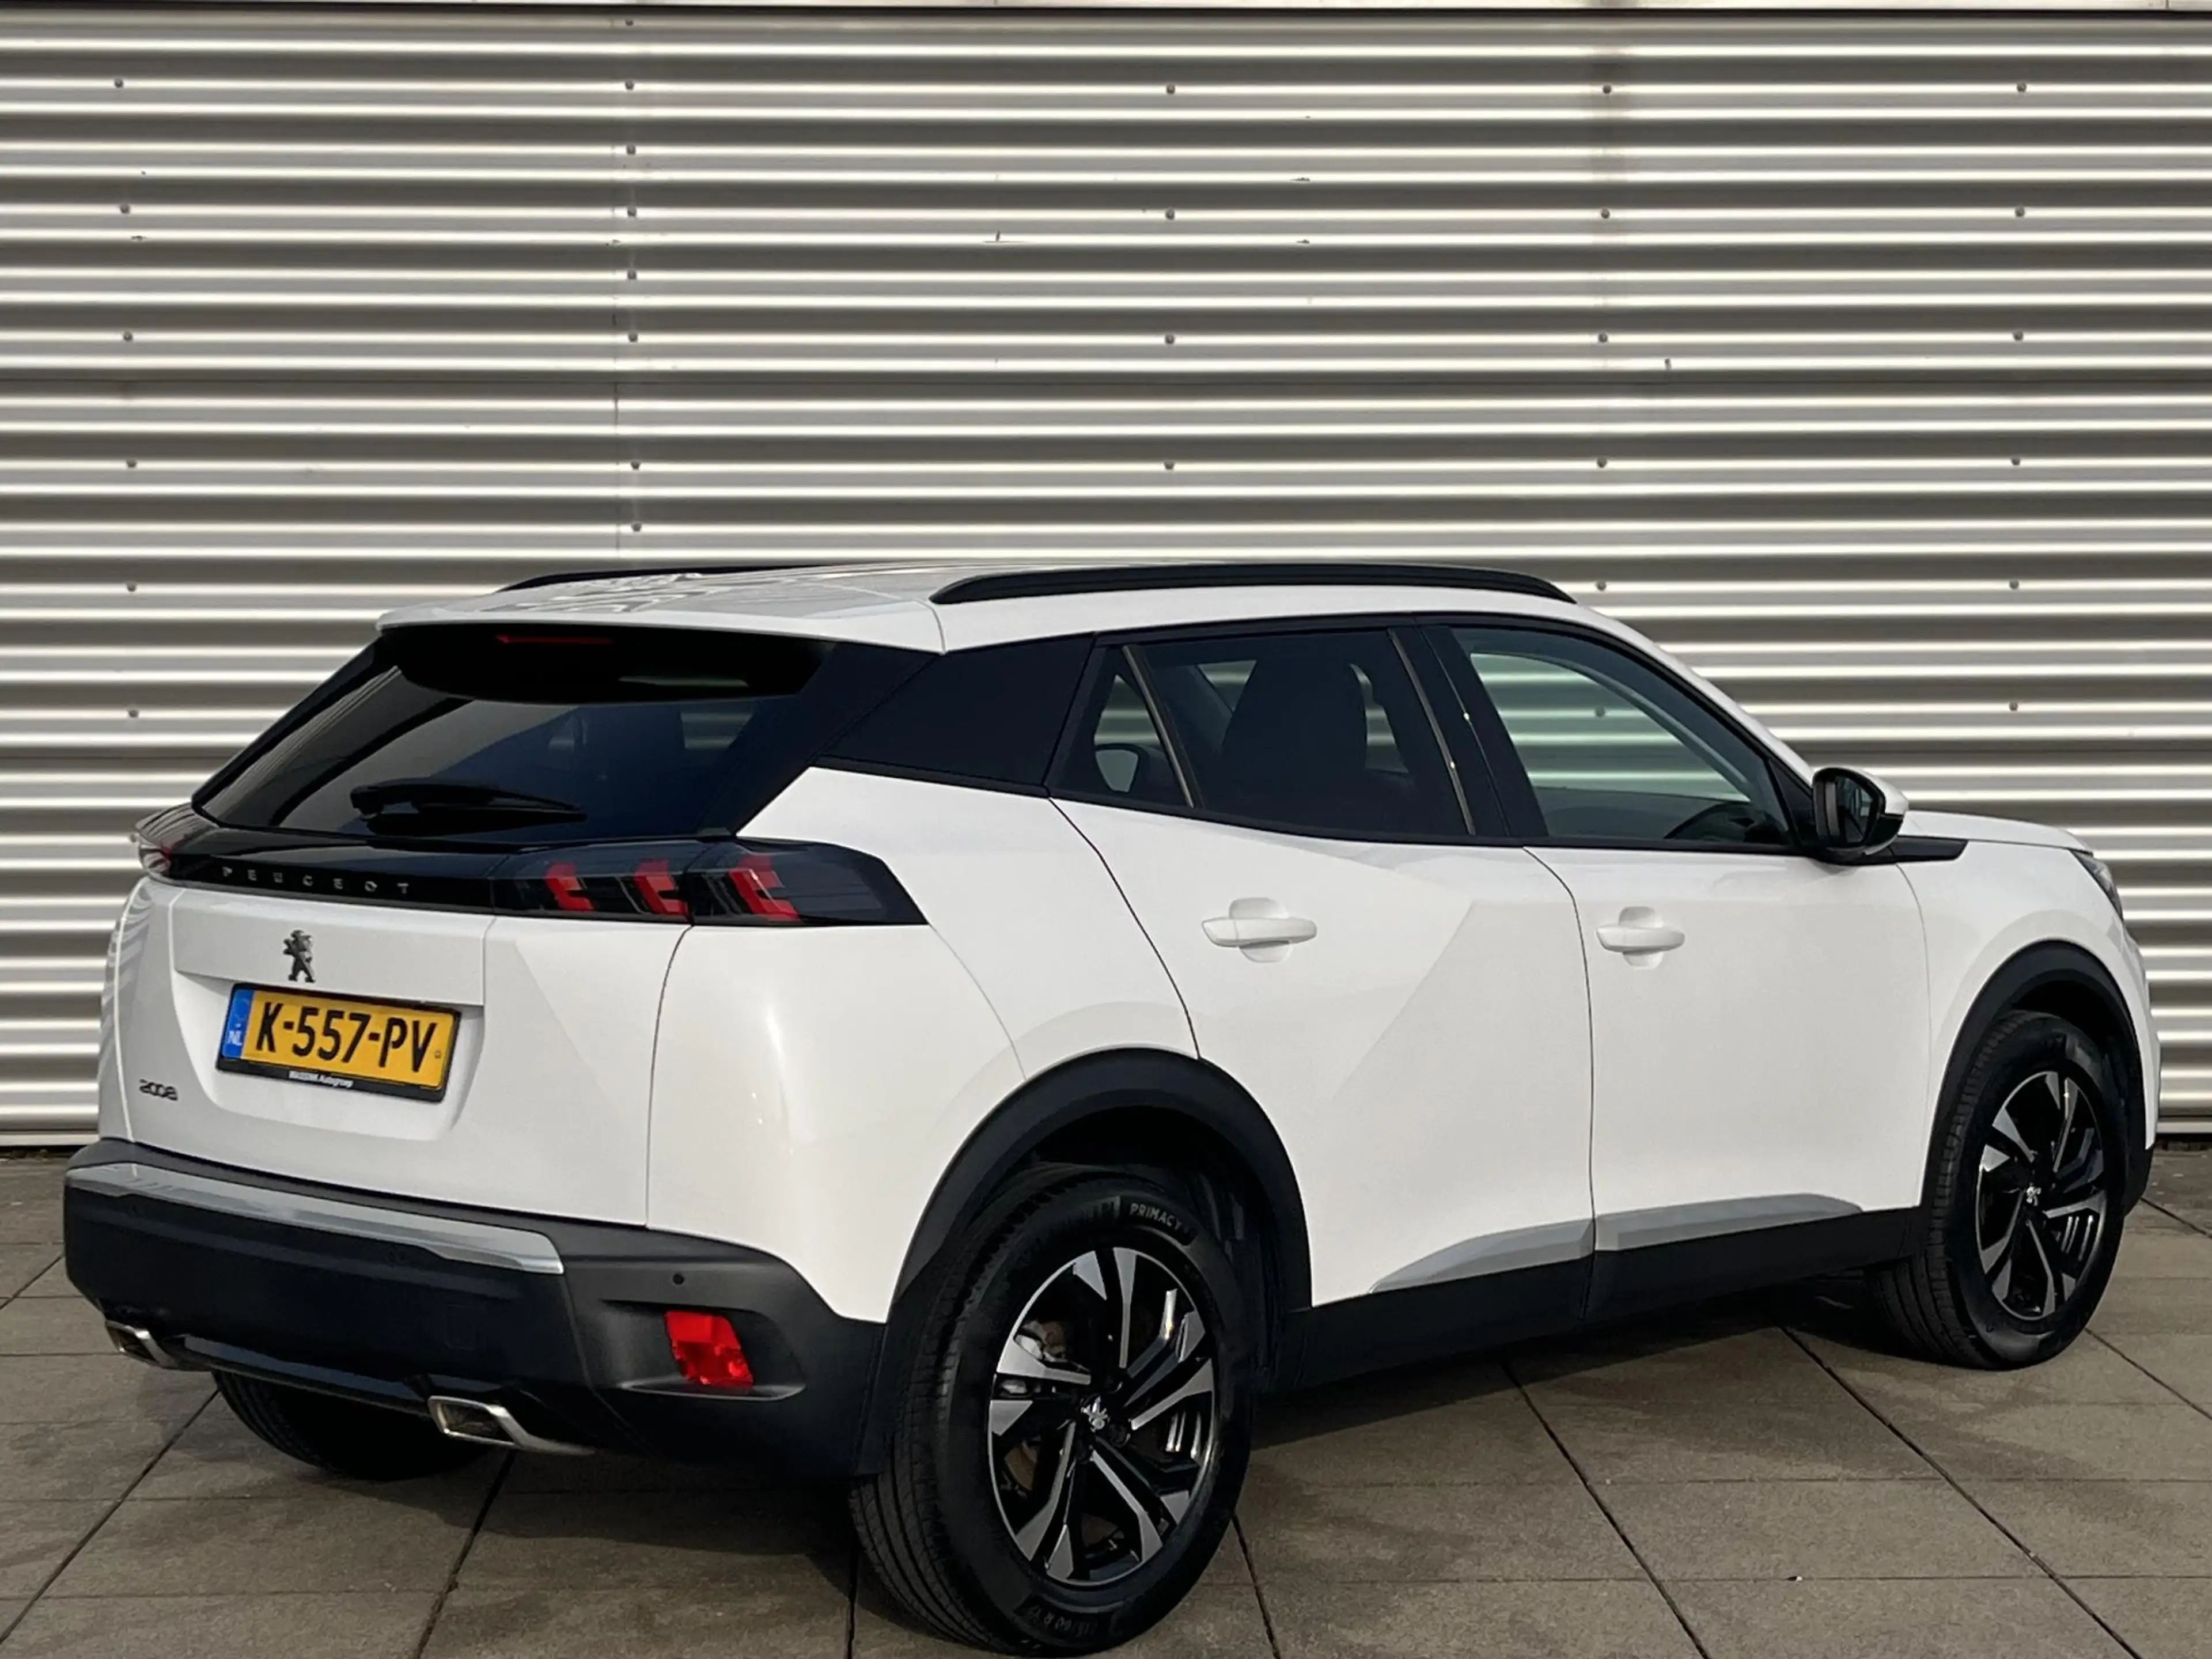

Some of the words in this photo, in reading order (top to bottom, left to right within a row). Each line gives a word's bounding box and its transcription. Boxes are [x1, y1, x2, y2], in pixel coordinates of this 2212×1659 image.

[222, 866, 409, 894] PEUGEOT
[256, 1002, 438, 1073] K-557-PV
[139, 1078, 178, 1101] 2008
[1130, 1202, 1183, 1232] PRIMACY
